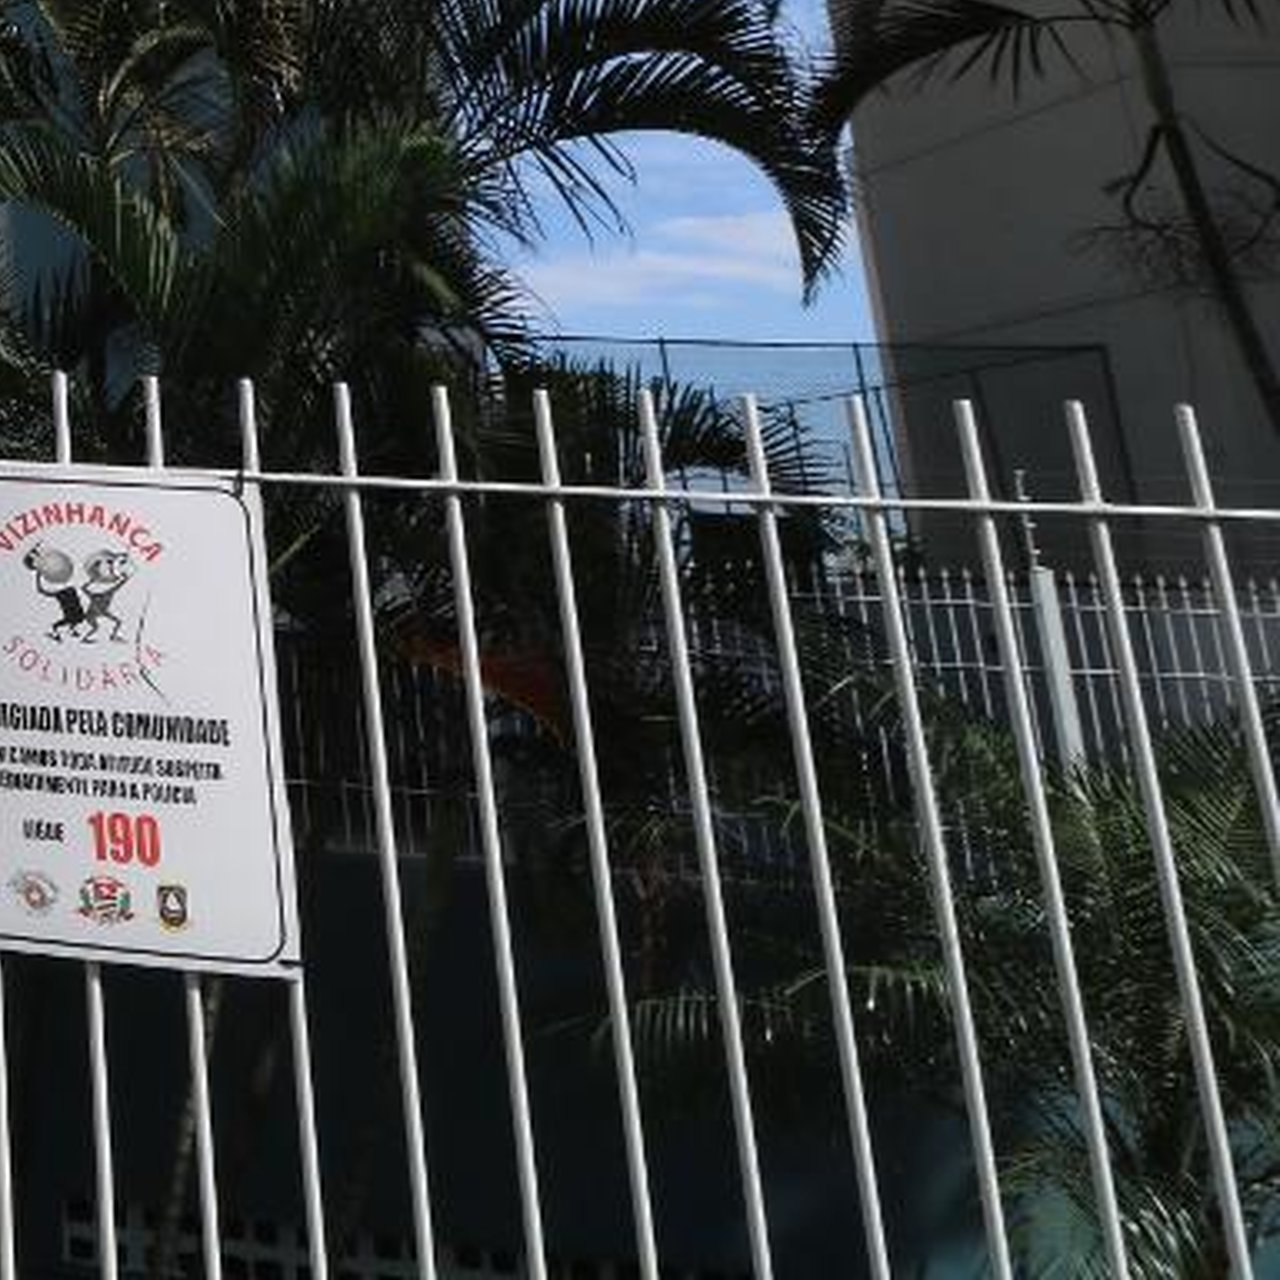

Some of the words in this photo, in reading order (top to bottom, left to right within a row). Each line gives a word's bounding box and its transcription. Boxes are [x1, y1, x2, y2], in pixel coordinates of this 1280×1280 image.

[65, 708, 108, 738] PELA
[111, 710, 231, 747] COMUNIDADE
[86, 810, 161, 867] 190
